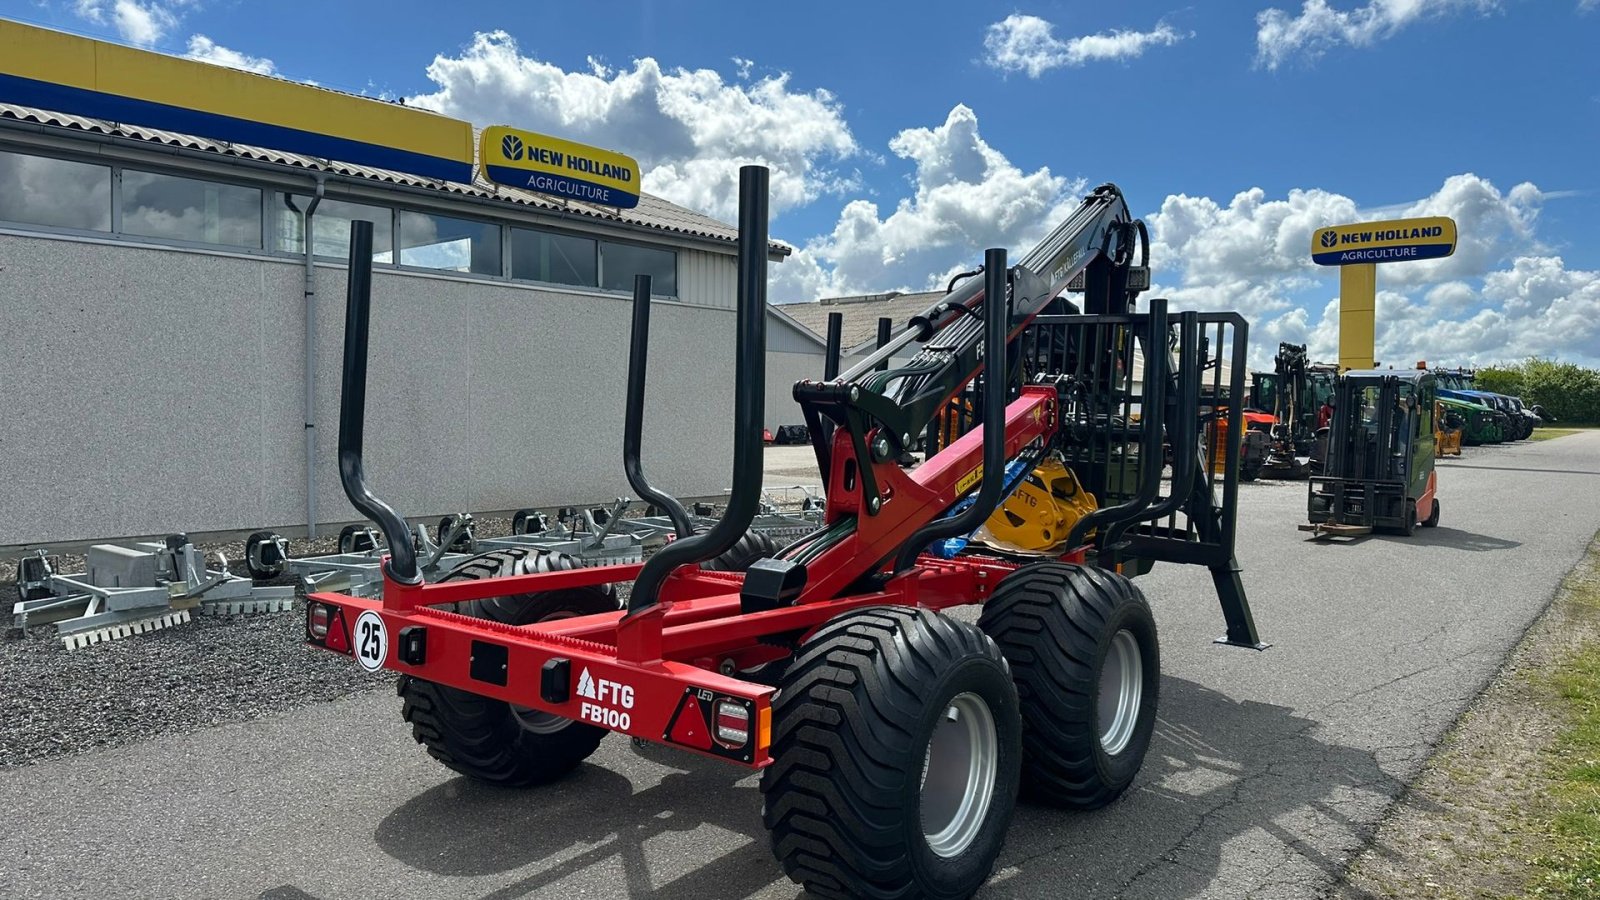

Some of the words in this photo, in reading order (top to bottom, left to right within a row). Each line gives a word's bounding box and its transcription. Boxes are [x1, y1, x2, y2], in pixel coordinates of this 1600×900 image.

[528, 146, 564, 167] NEW
[567, 155, 631, 182] HOLLAND
[527, 175, 609, 202] AGRICULTURE
[1341, 231, 1373, 244] NEW
[1375, 226, 1442, 242] HOLLAND
[1341, 247, 1417, 261] AGRICULTURE
[1017, 489, 1038, 508] FTG
[361, 621, 380, 661] 25
[598, 678, 635, 709] FTG
[697, 689, 713, 702] LED
[581, 702, 631, 731] FB100
